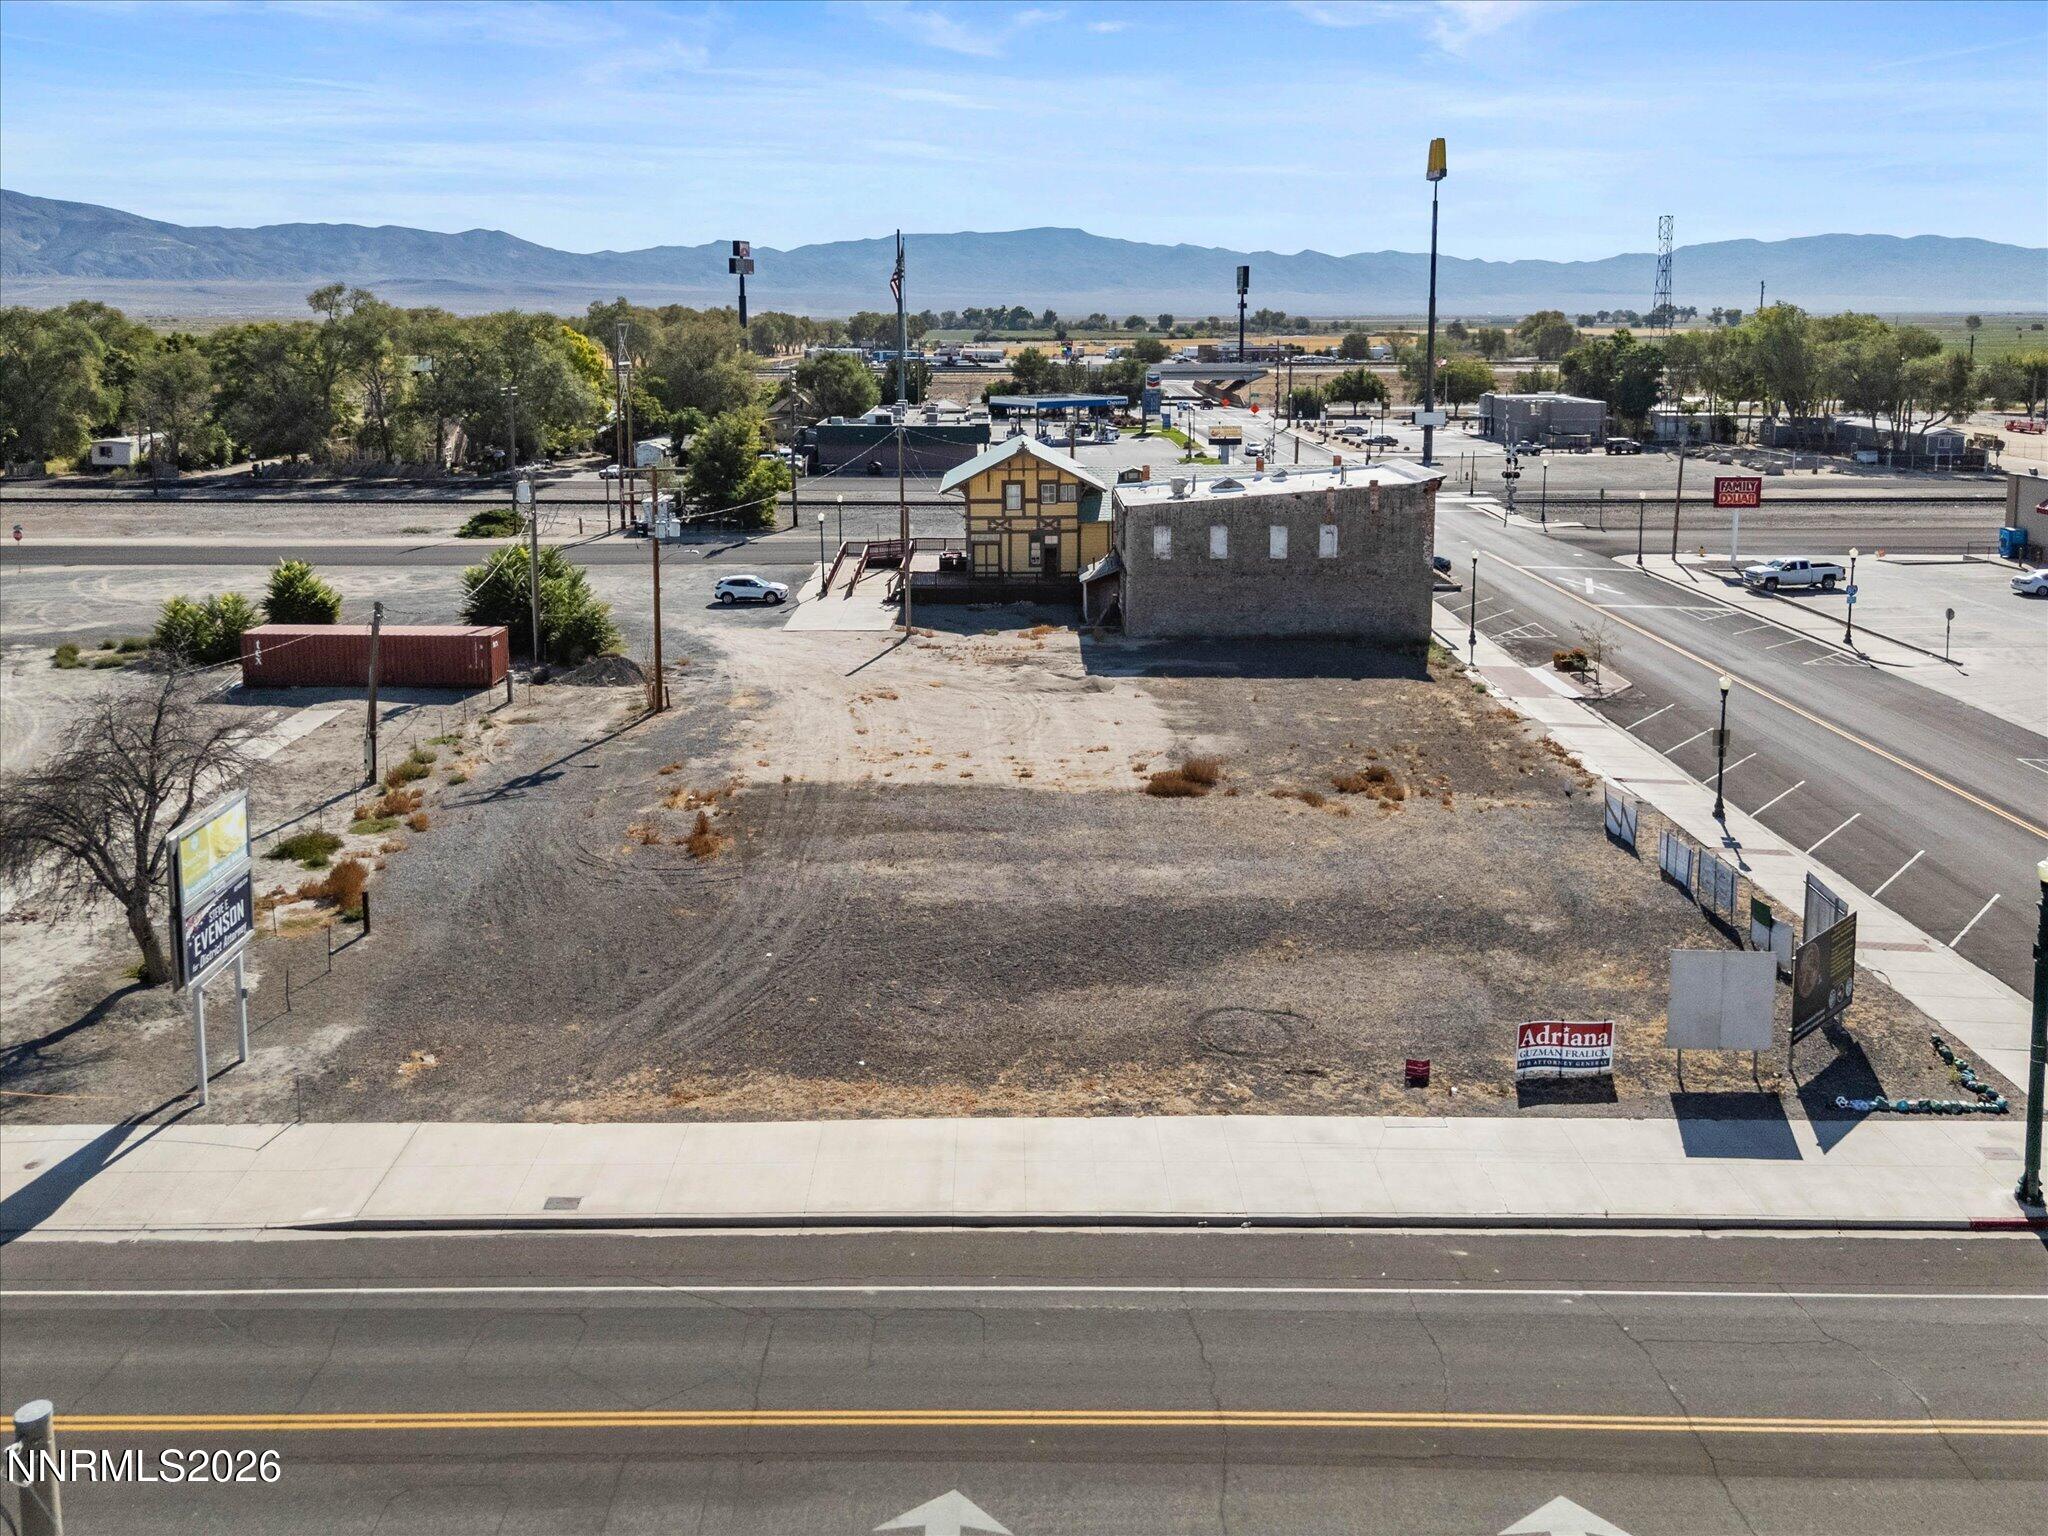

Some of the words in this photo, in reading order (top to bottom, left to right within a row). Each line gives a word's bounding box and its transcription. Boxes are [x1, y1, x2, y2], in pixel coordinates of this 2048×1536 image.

[1719, 480, 1758, 493] FAMILY
[1718, 493, 1757, 505] DOLLAR
[208, 903, 224, 923] STEVE
[193, 898, 245, 958] EVENSON
[199, 942, 223, 969] District
[223, 921, 248, 949] Attorney
[1520, 1025, 1609, 1047] Adriana
[1519, 1048, 1563, 1058] GUZMAN
[1565, 1048, 1608, 1058] FRALICK
[1533, 1059, 1572, 1067] ATTORNEY
[1575, 1059, 1608, 1067] GENERAL
